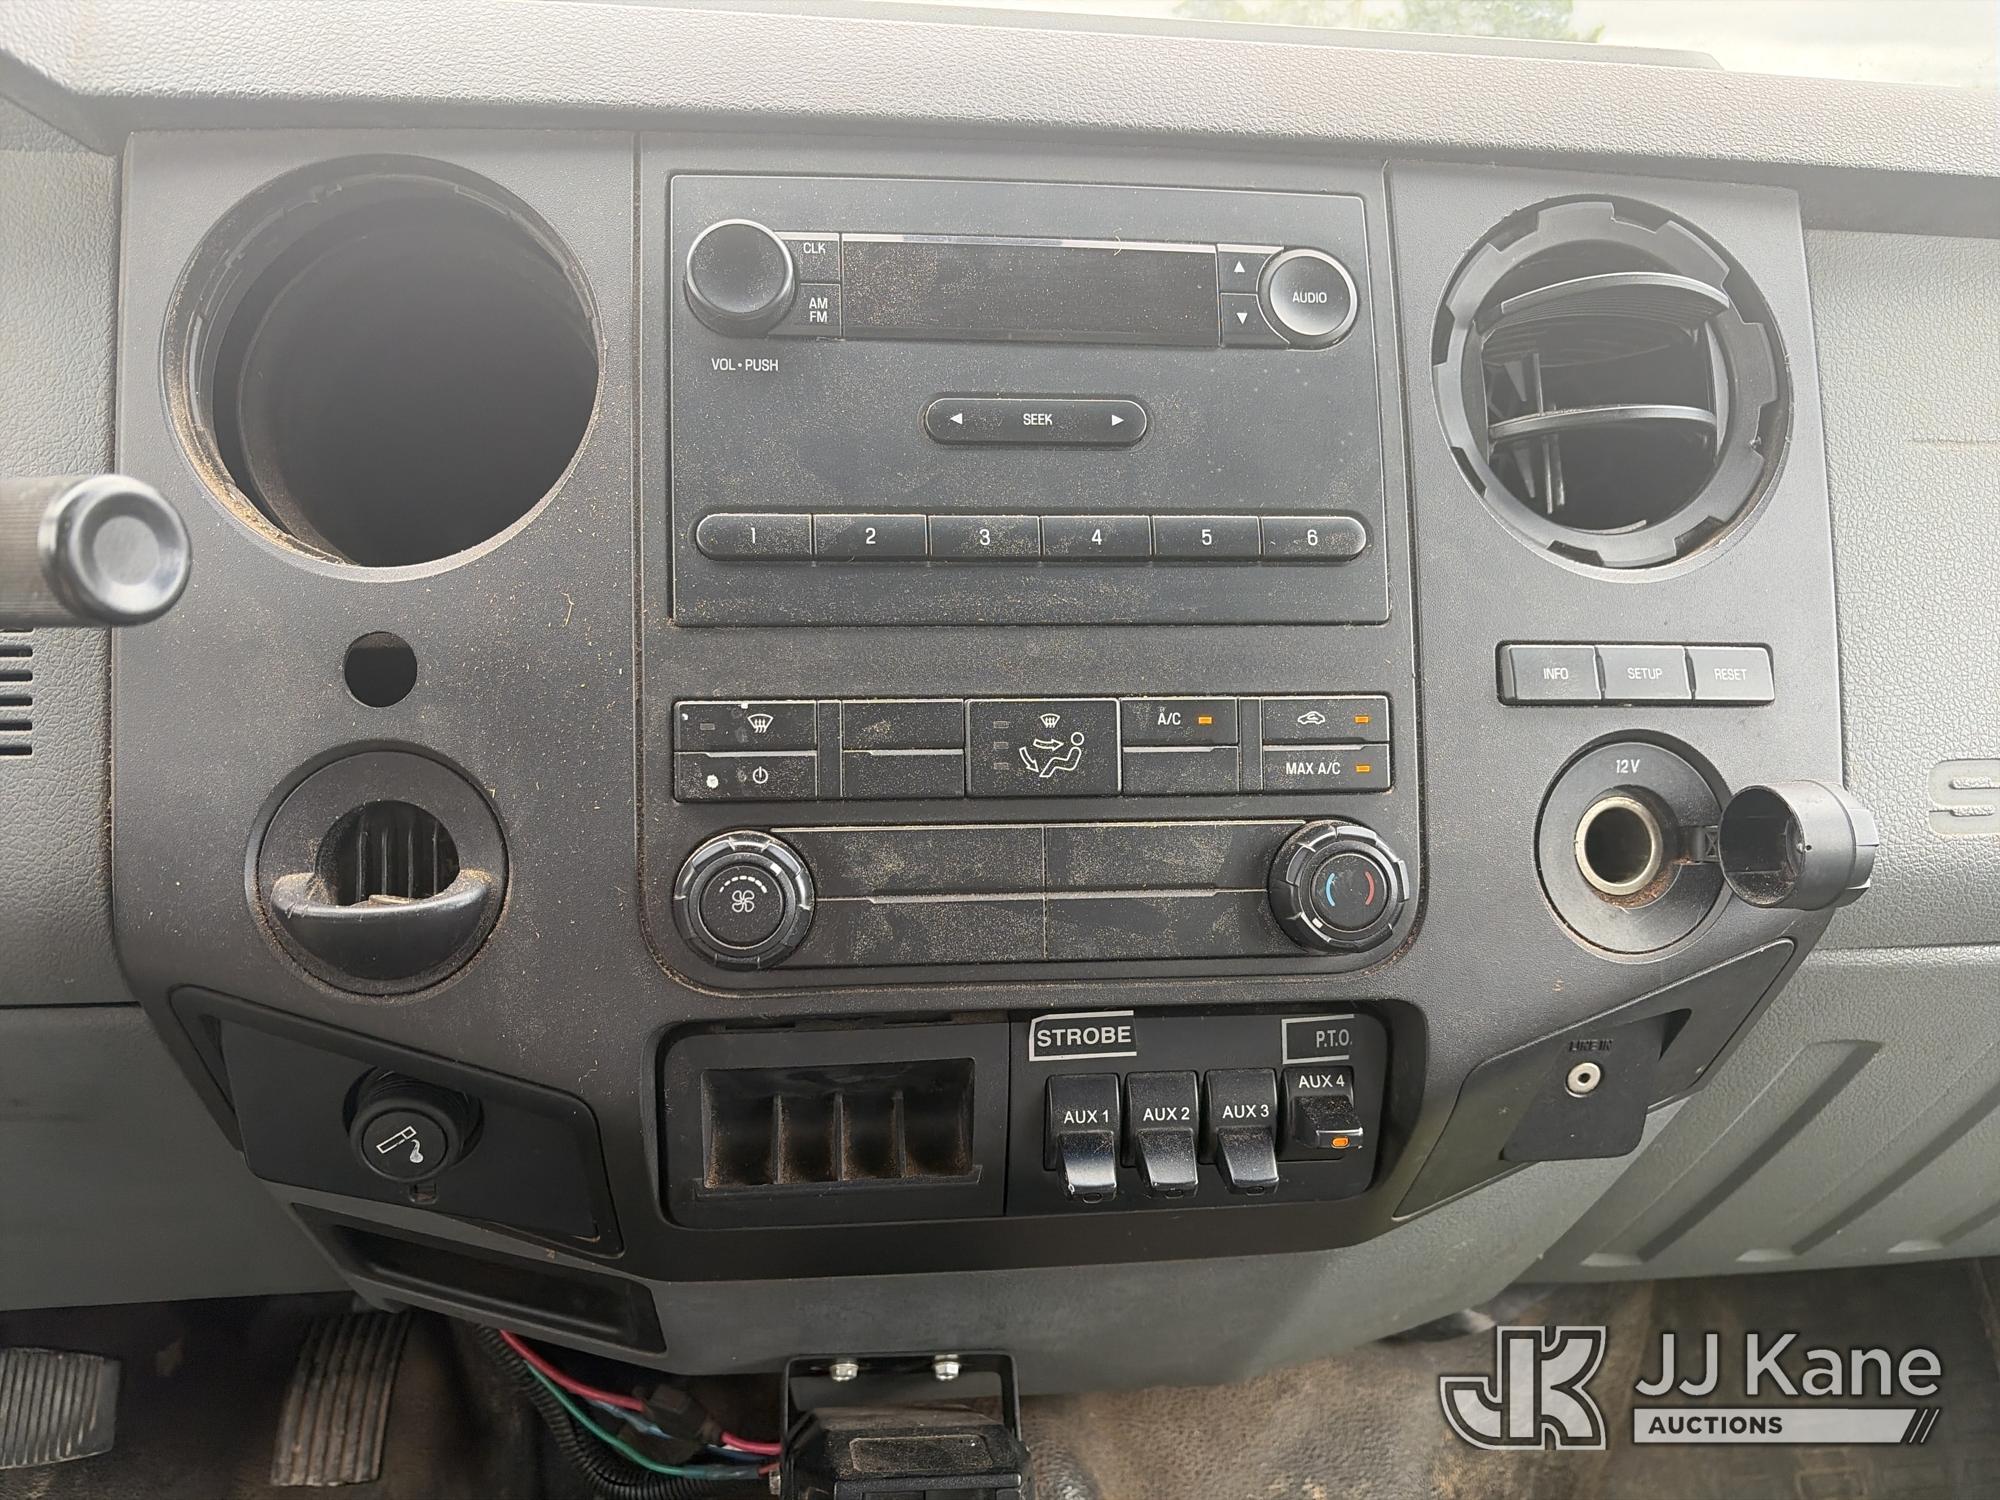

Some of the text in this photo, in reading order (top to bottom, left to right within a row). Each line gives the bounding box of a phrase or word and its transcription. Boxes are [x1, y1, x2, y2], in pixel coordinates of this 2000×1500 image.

[803, 242, 826, 254] CLK
[808, 297, 828, 309] AM
[1291, 290, 1327, 305] AUDIO
[809, 311, 828, 323] FM
[711, 358, 779, 372] VOL PUSH
[1022, 412, 1054, 427] SEEK
[749, 527, 757, 545] 1
[864, 528, 877, 545] 2
[978, 530, 992, 546] 3
[1090, 529, 1103, 546] 4
[1201, 529, 1213, 546] 5
[1306, 529, 1320, 546] 6
[1543, 667, 1569, 680] INFO
[1627, 667, 1663, 680] SETUP
[1713, 667, 1748, 680] RESET
[1157, 712, 1181, 726] A/C
[1286, 762, 1341, 775] MAX A/C
[1037, 1026, 1131, 1047] STROBE
[1299, 1074, 1345, 1089] AUX 4
[1063, 1109, 1110, 1124] AUX 1
[1143, 1107, 1190, 1121] AUX 2
[1222, 1104, 1270, 1119] AUX 3
